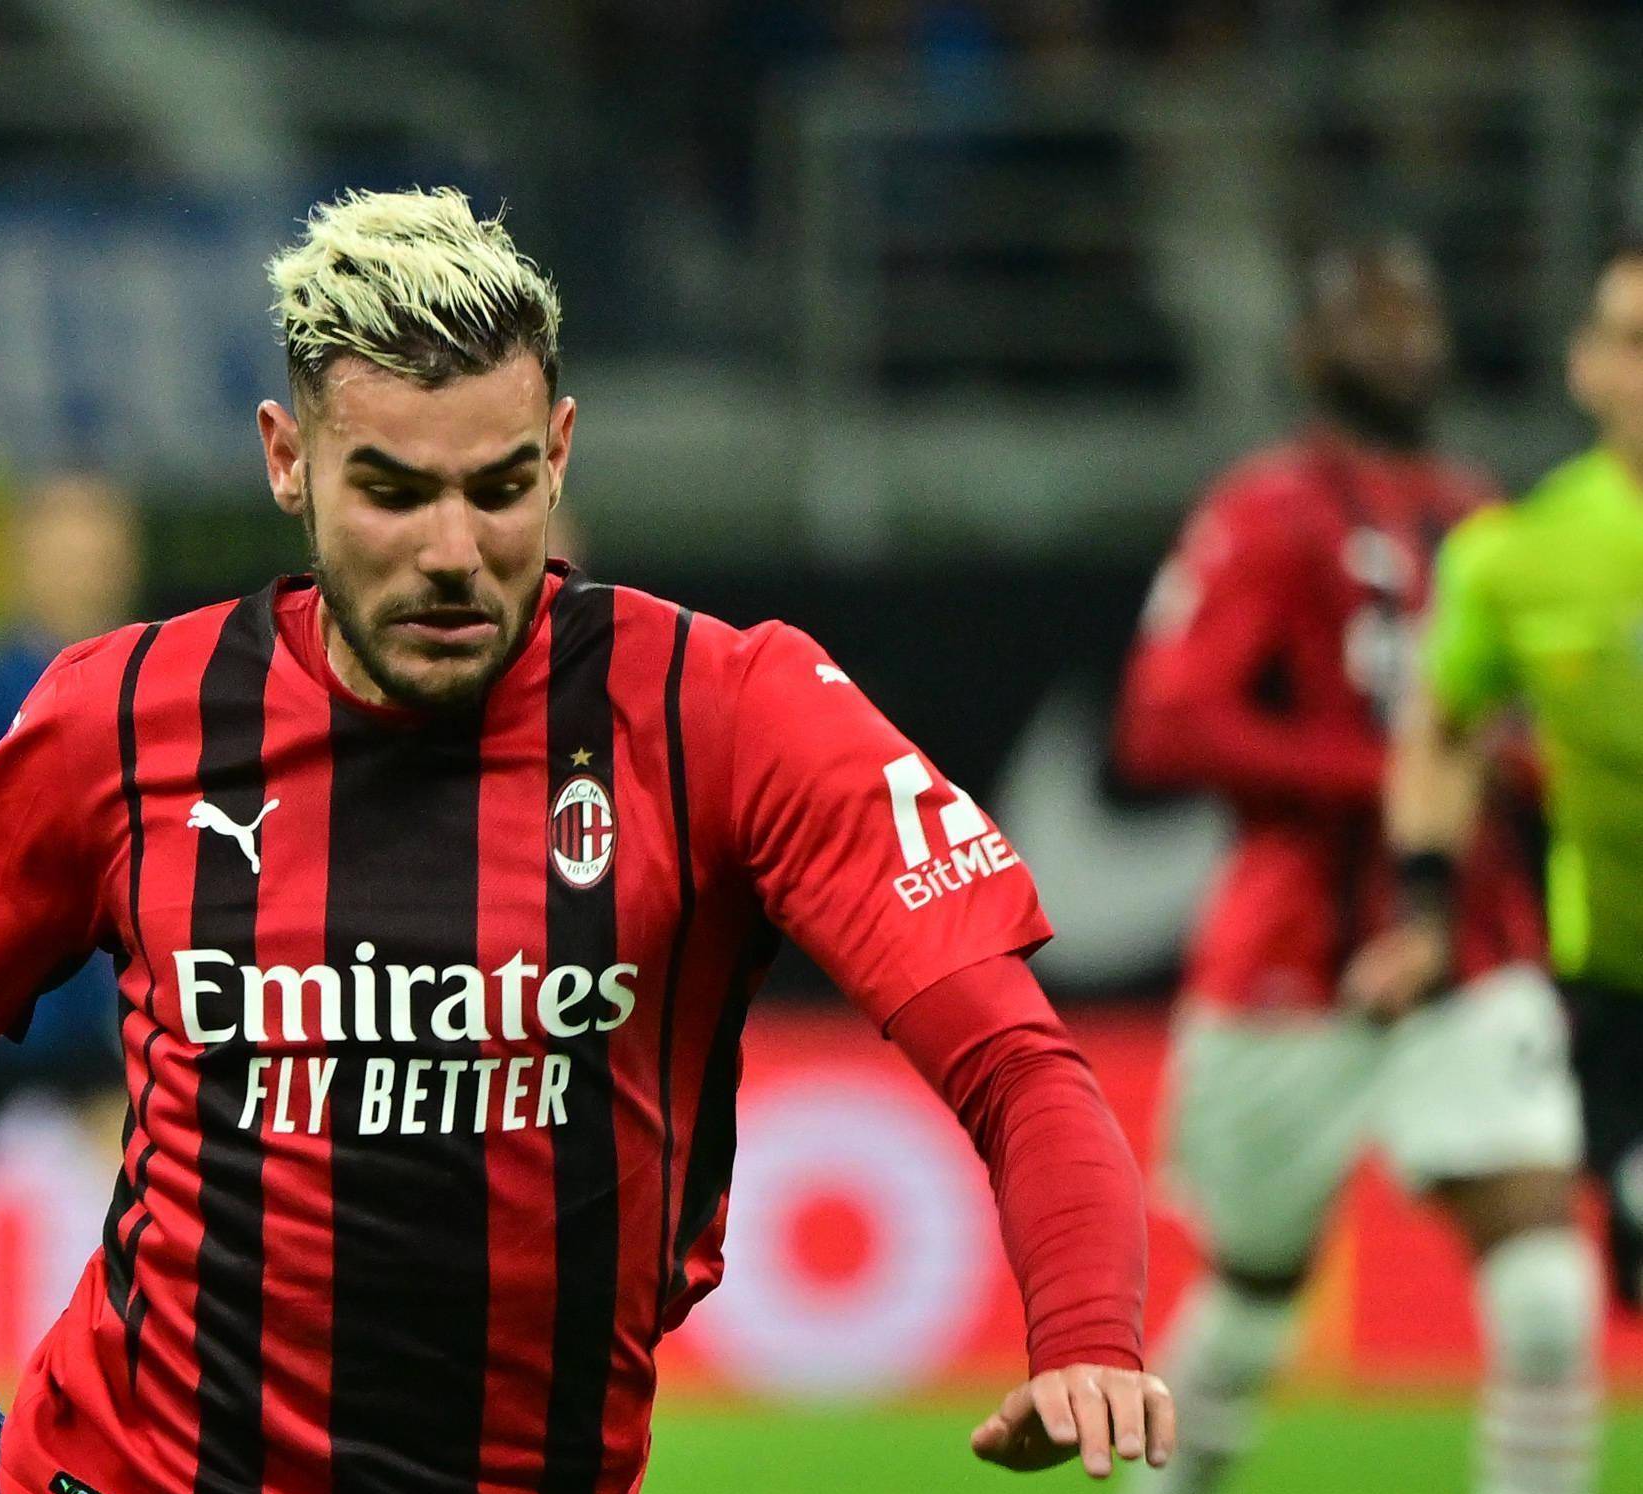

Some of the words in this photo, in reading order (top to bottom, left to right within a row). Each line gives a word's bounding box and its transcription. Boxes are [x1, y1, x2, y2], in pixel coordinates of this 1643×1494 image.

[171, 941, 638, 1044] Emirates
[238, 1057, 338, 1135] FLY
[358, 1054, 572, 1136] BETTER
